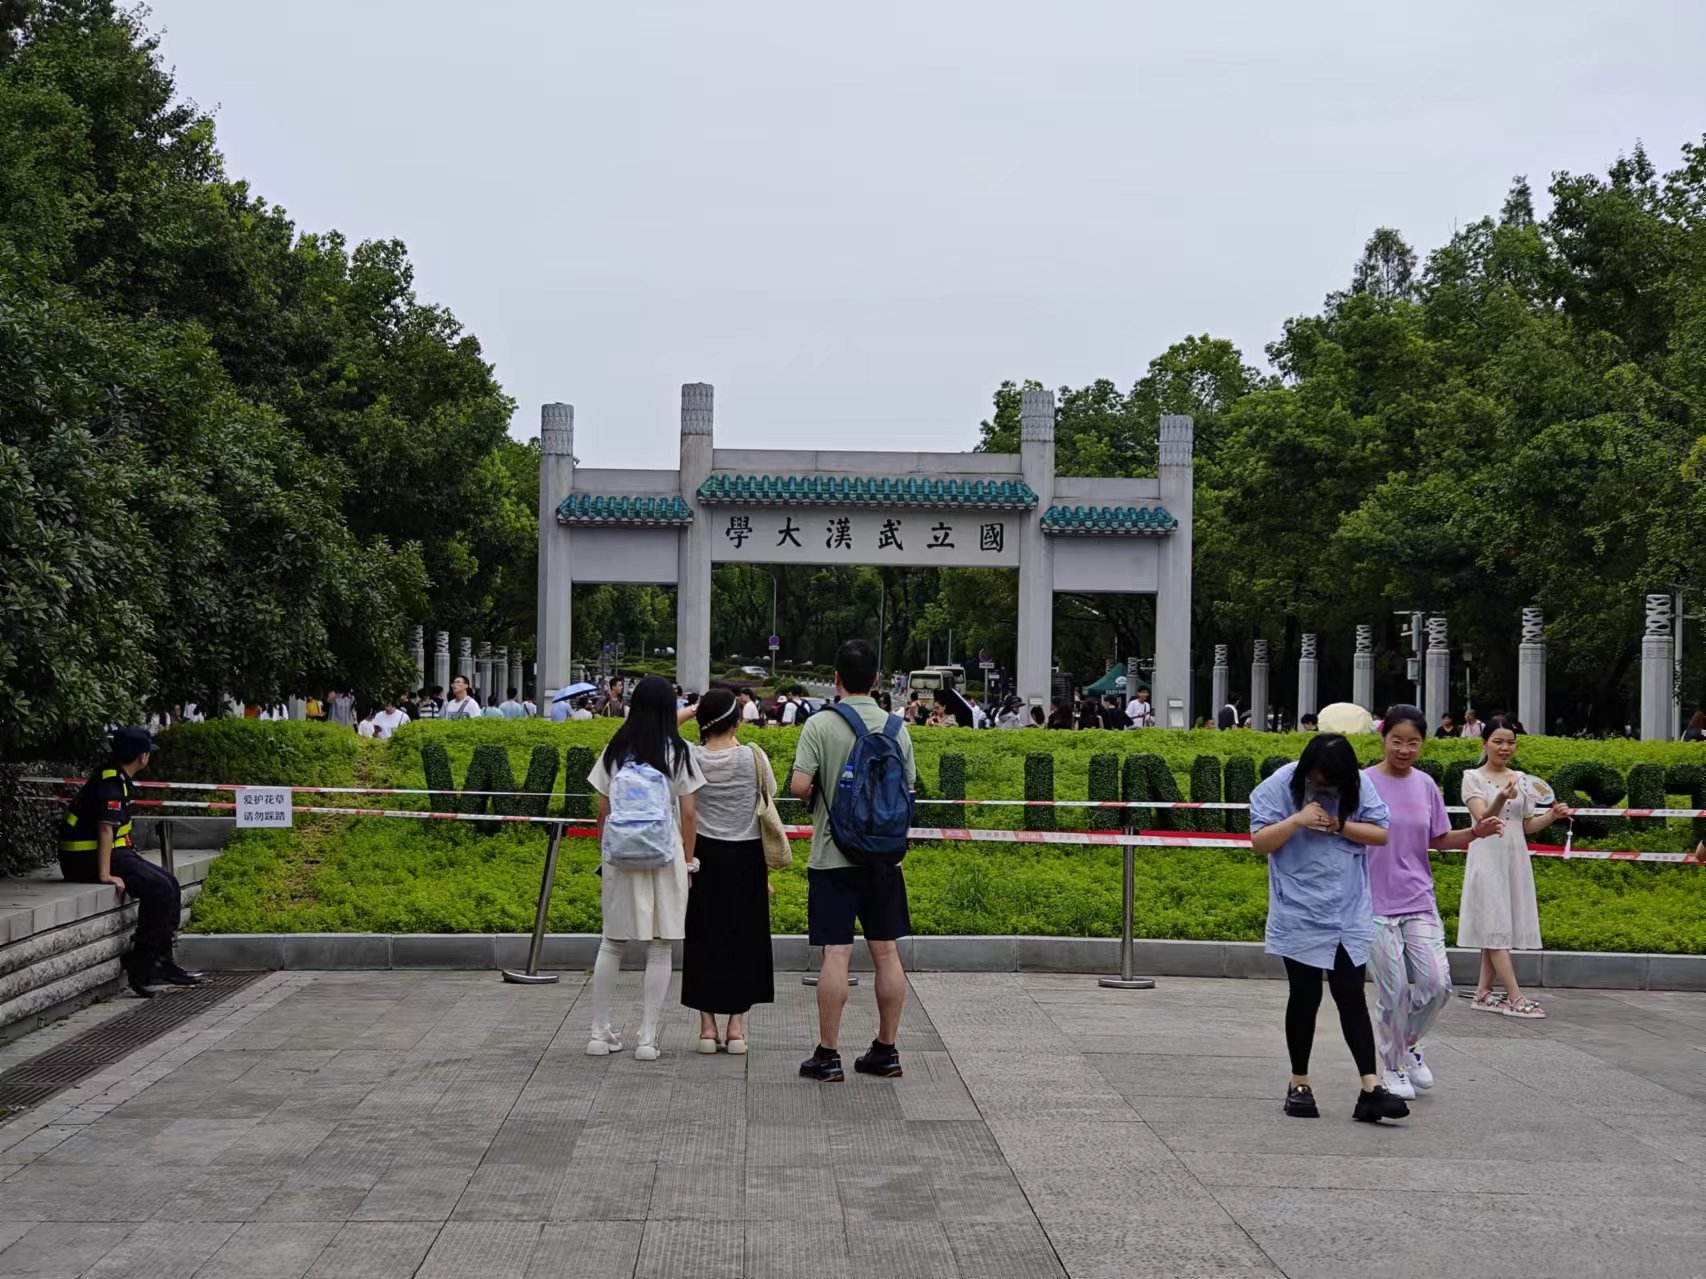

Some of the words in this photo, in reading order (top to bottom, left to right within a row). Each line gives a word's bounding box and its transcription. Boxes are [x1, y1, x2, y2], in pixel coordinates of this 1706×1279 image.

[243, 794, 285, 805] 爱护花草
[243, 810, 286, 821] 请勿踩踏
